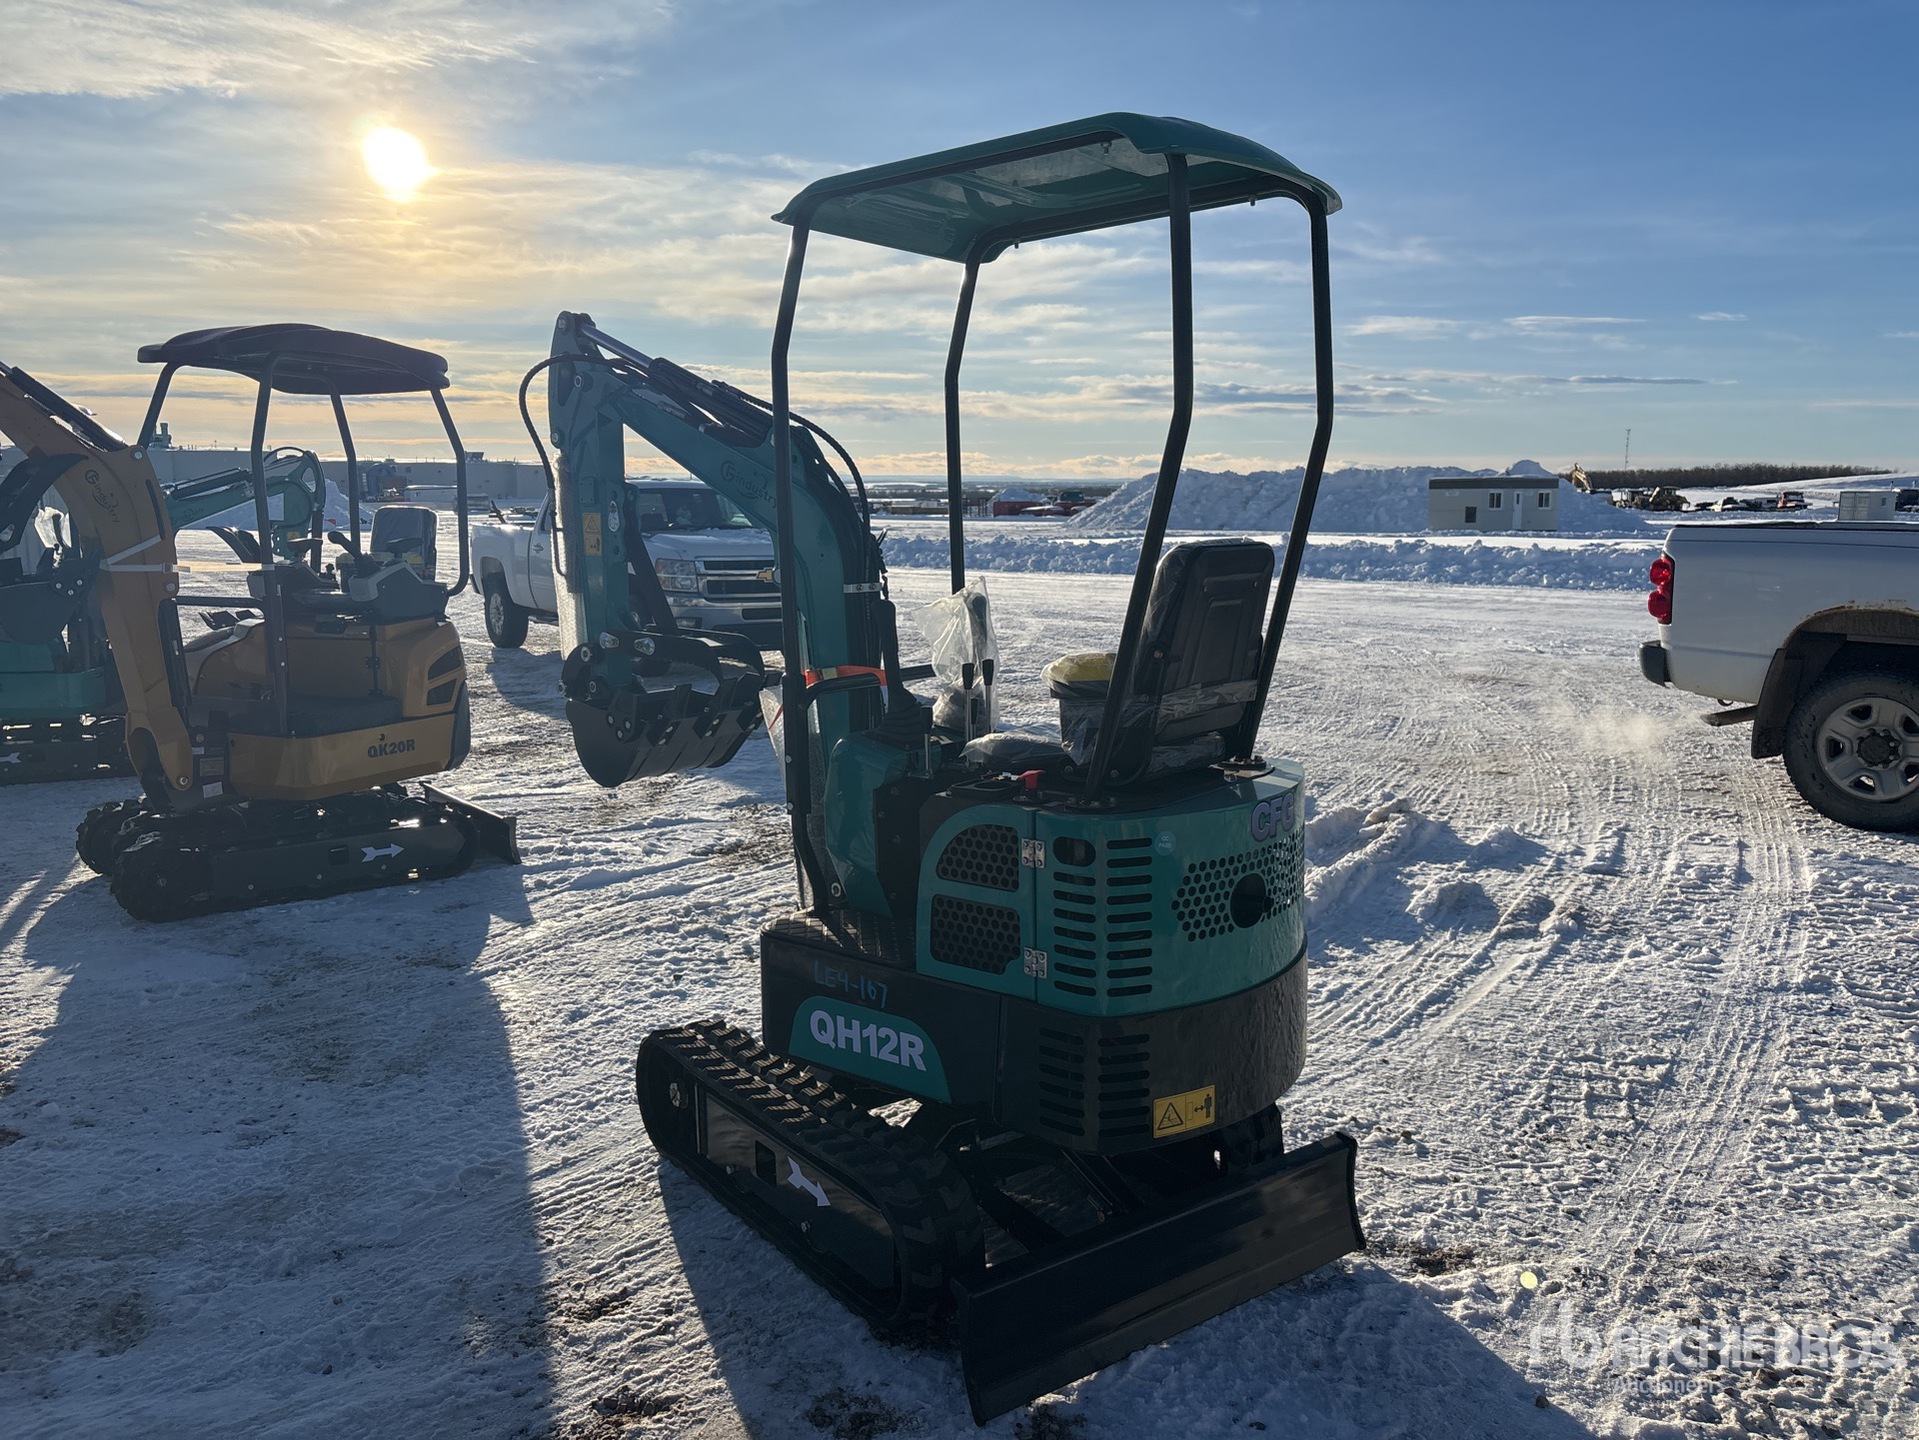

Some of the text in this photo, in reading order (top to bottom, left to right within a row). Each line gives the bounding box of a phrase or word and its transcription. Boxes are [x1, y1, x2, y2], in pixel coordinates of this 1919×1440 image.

[367, 738, 416, 758] QK20R
[1251, 791, 1294, 842] CFG
[814, 959, 889, 1009] LE4-167
[809, 1009, 928, 1072] QH12R
